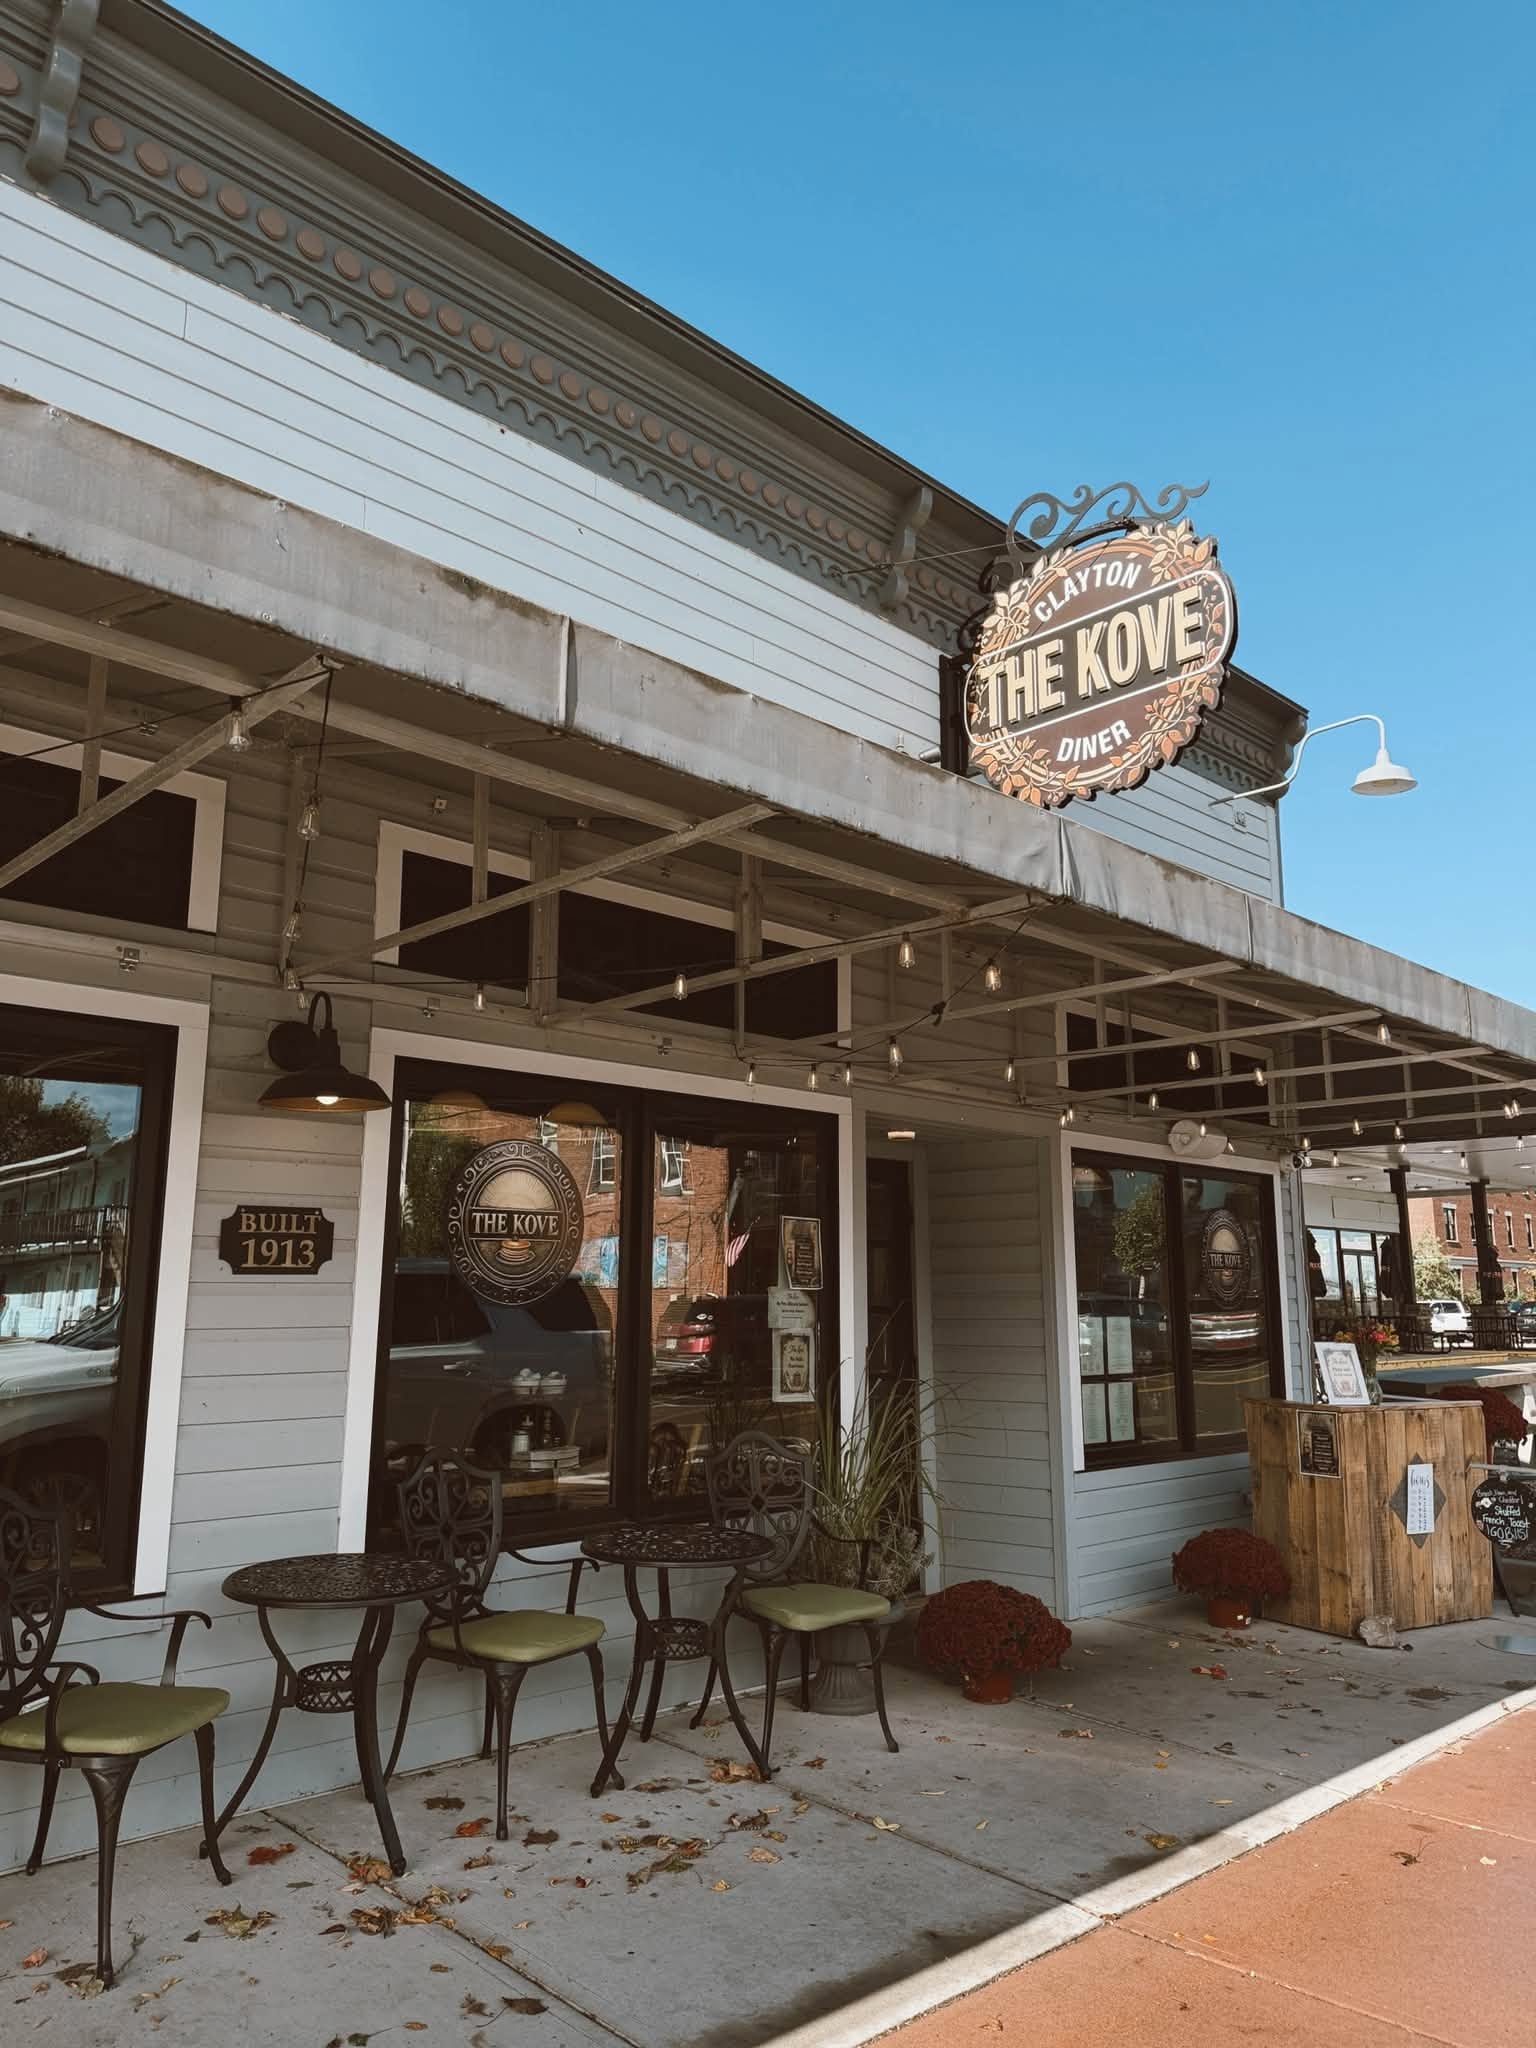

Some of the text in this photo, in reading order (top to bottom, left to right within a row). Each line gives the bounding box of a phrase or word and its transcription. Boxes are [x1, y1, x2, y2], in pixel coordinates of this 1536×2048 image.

[1034, 560, 1142, 623] CLAYTON
[979, 585, 1205, 729] THE KOVE
[1056, 719, 1132, 762] DINER
[238, 1212, 321, 1234] BUILT
[471, 1212, 560, 1236] THE KOVE
[240, 1238, 315, 1268] 1913
[1209, 1253, 1223, 1267] THE
[1482, 1513, 1531, 1528] French Toast
